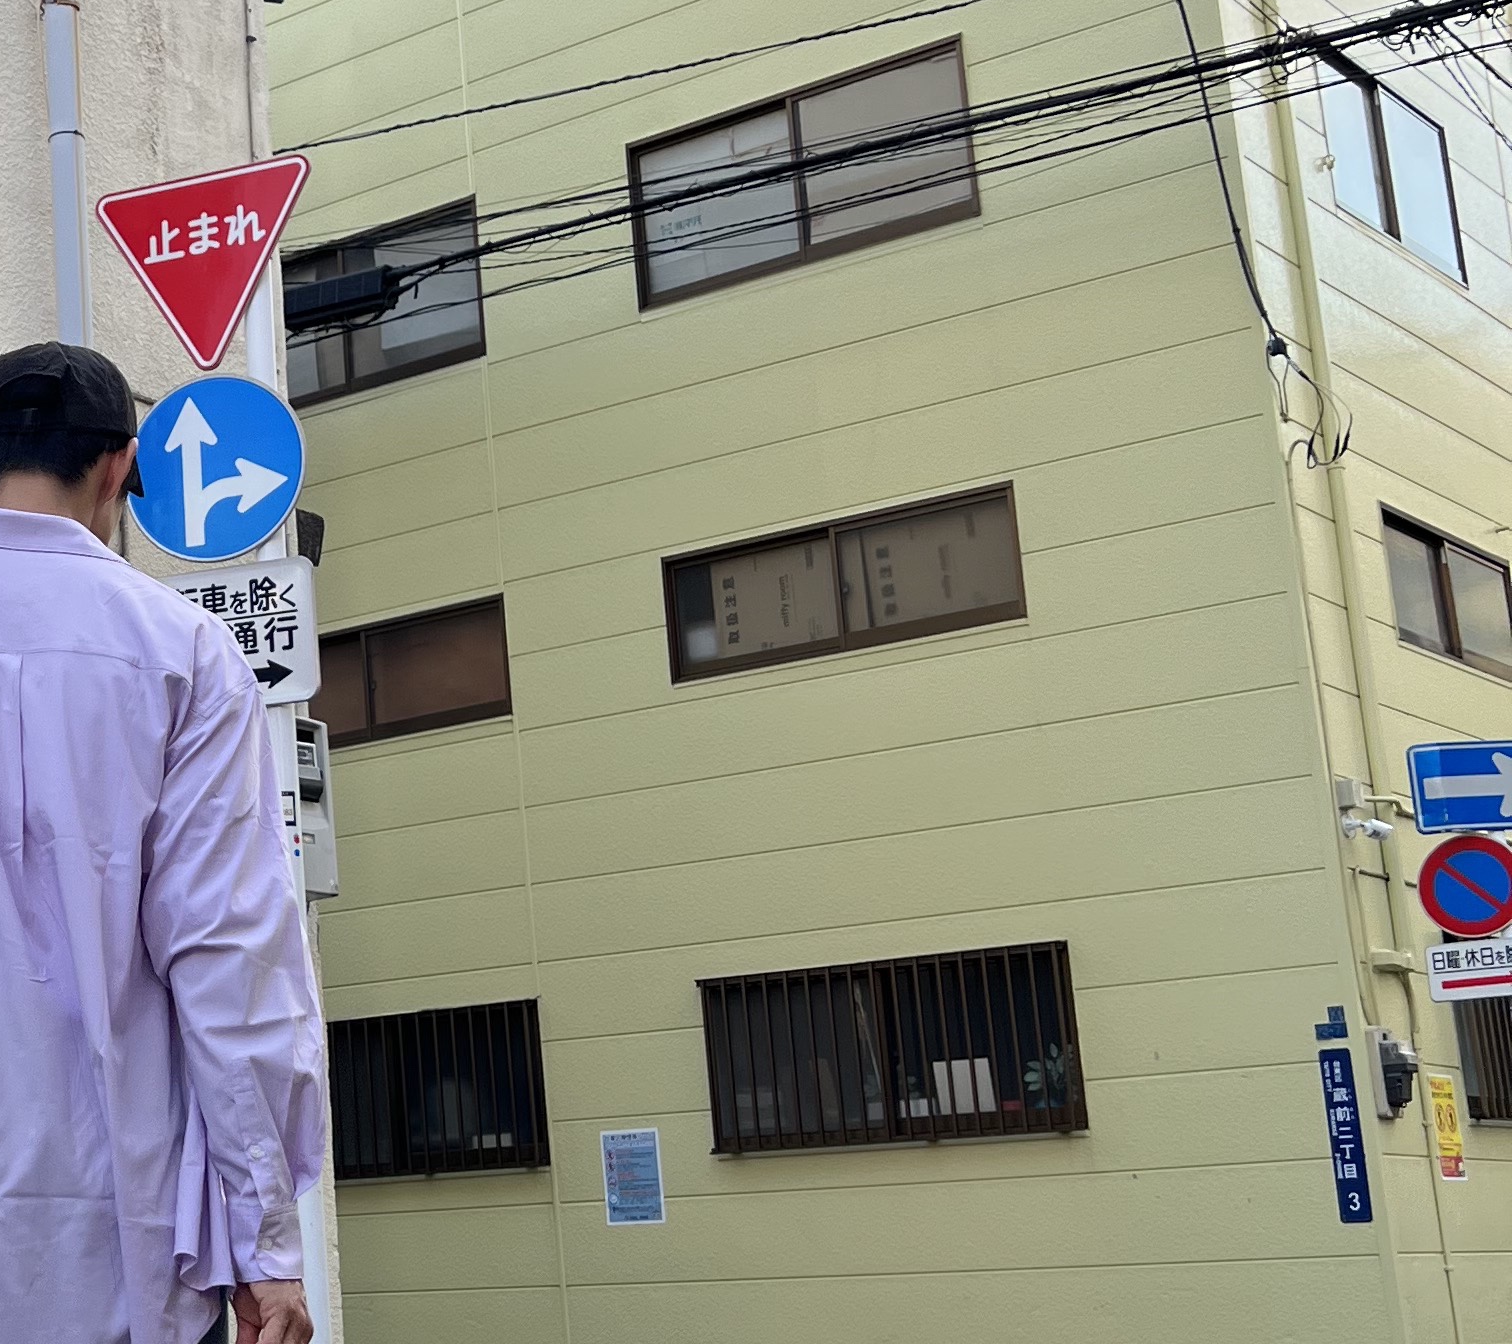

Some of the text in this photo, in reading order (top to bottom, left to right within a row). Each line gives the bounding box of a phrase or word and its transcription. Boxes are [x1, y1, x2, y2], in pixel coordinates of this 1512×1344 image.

[144, 205, 266, 264] 止まれ
[1348, 1192, 1360, 1211] 3
